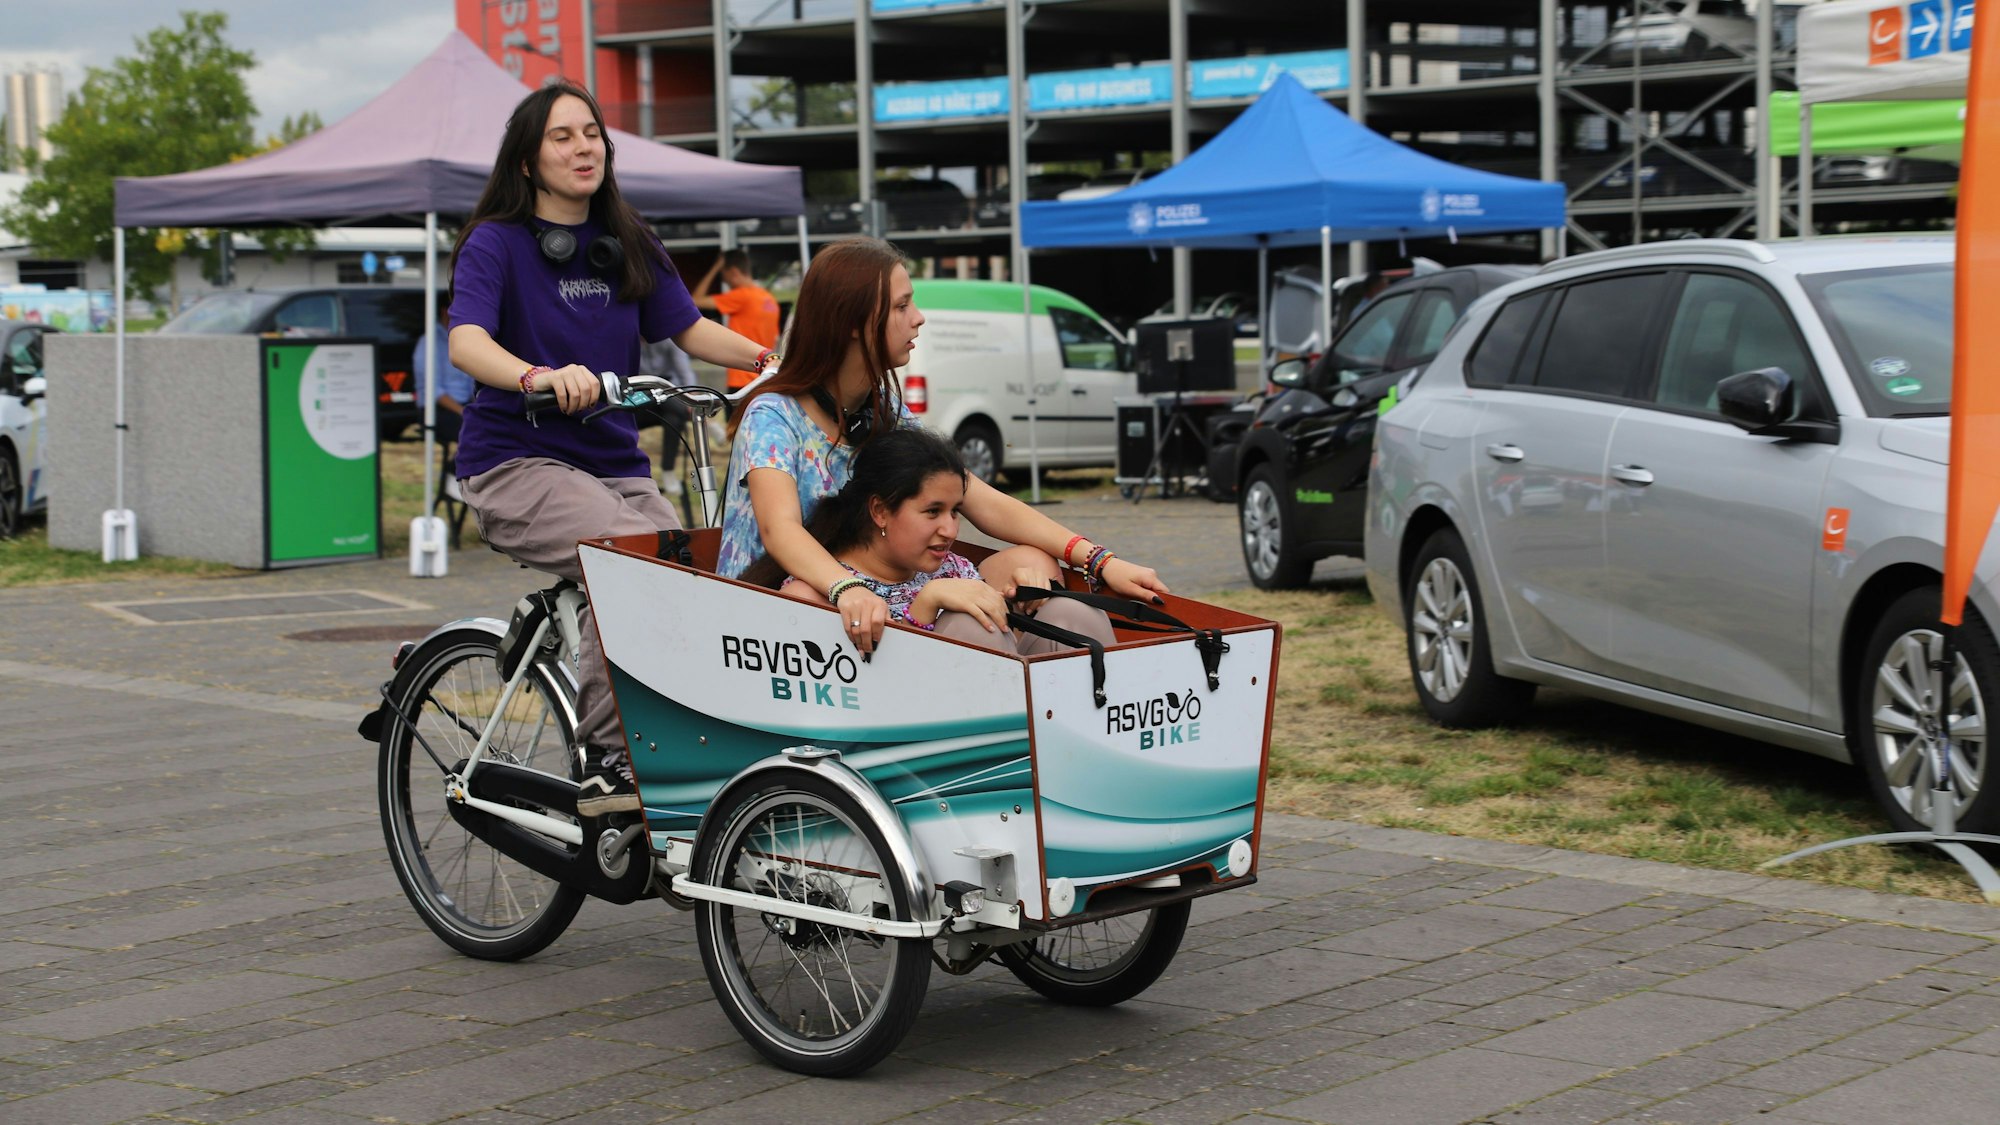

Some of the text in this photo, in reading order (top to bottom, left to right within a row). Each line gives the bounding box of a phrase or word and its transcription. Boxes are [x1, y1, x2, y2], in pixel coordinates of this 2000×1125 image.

[1100, 77, 1152, 97] BUSINESS
[1156, 204, 1201, 219] POLIZEI
[1443, 193, 1480, 209] POLIZEI
[721, 634, 803, 677] RSVG
[771, 676, 861, 711] BIKE
[1107, 698, 1164, 735] RSVG
[1140, 721, 1201, 751] BIKE
